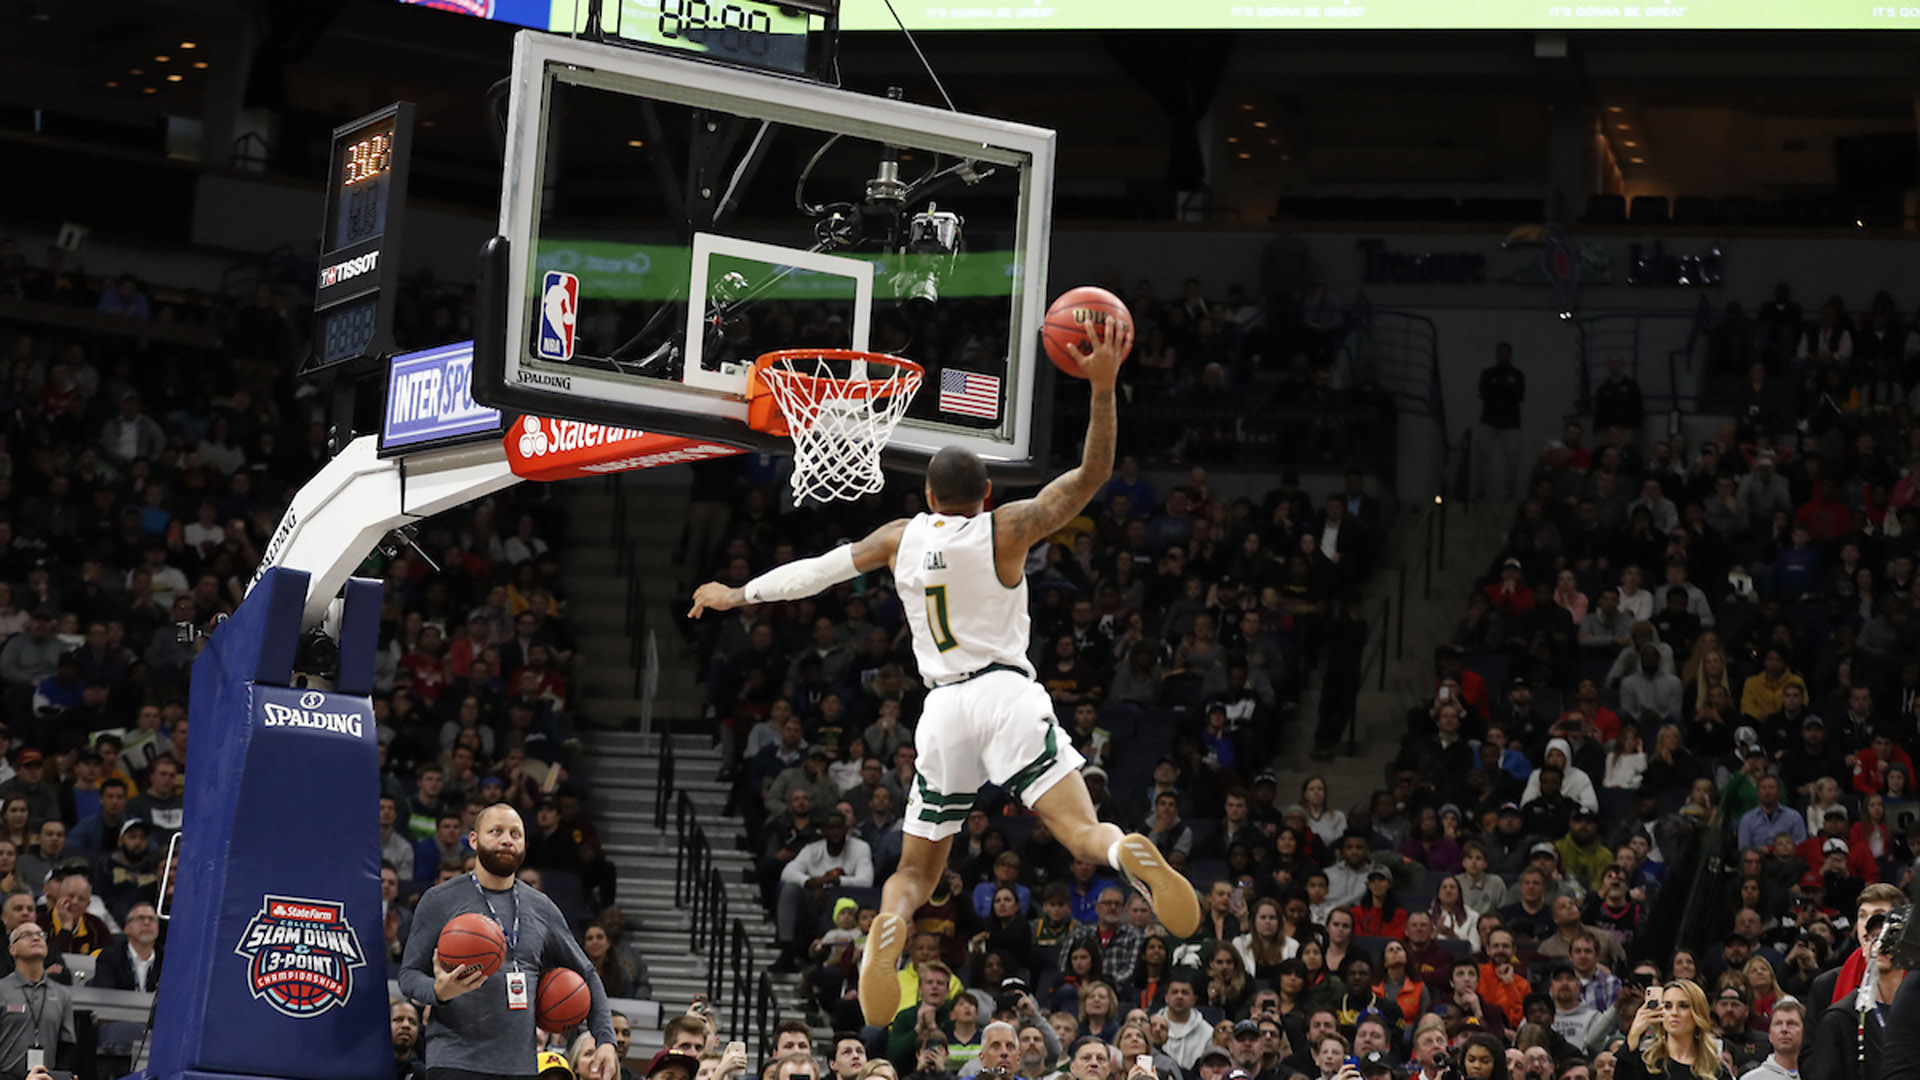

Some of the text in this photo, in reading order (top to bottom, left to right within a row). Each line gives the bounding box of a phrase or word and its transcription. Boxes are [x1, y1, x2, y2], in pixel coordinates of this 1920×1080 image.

[337, 251, 380, 283] TISSOT
[1356, 239, 1486, 283] Treasure
[543, 338, 561, 352] NBA
[393, 362, 478, 425] INTERSPO
[516, 369, 571, 391] SPALDING
[923, 550, 948, 571] EAL
[924, 583, 960, 655] 0
[263, 702, 363, 739] SPALDING
[279, 919, 326, 930] COLLEGE
[246, 924, 359, 959] SLAM DUNK
[267, 951, 334, 977] 3-POINT
[256, 970, 344, 995] CHAMPIONSHIPS
